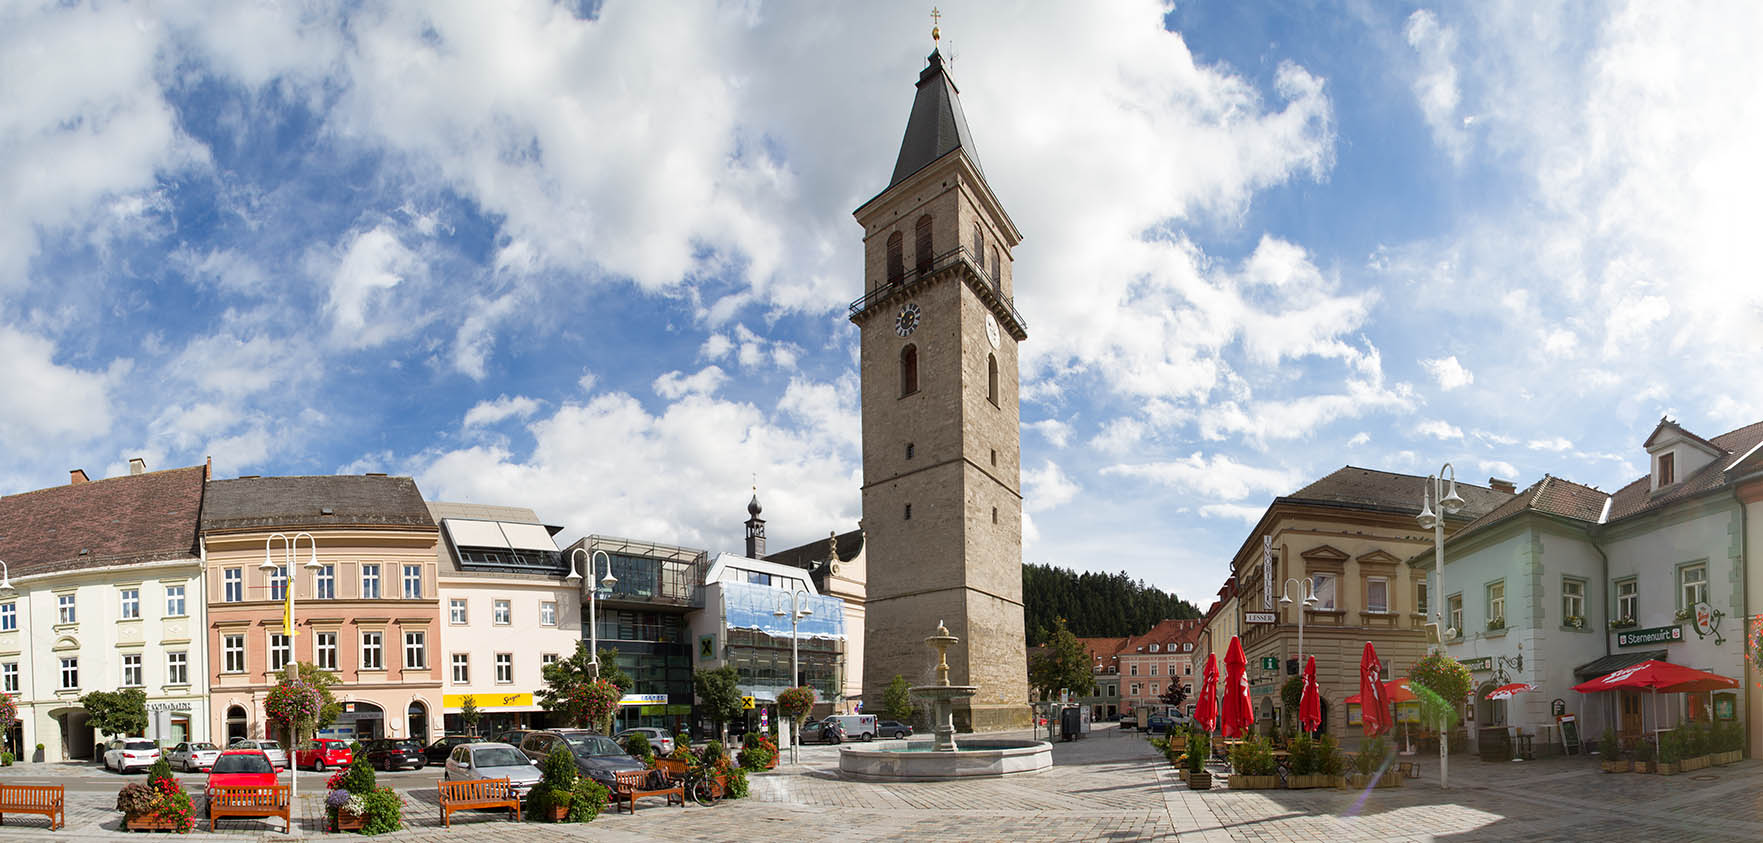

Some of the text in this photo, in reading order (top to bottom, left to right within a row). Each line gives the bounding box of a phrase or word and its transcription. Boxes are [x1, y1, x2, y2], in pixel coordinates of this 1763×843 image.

[1264, 536, 1272, 609] IMMOBILIEN
[1248, 614, 1273, 622] LESSER
[1628, 629, 1670, 644] Sternenwirt
